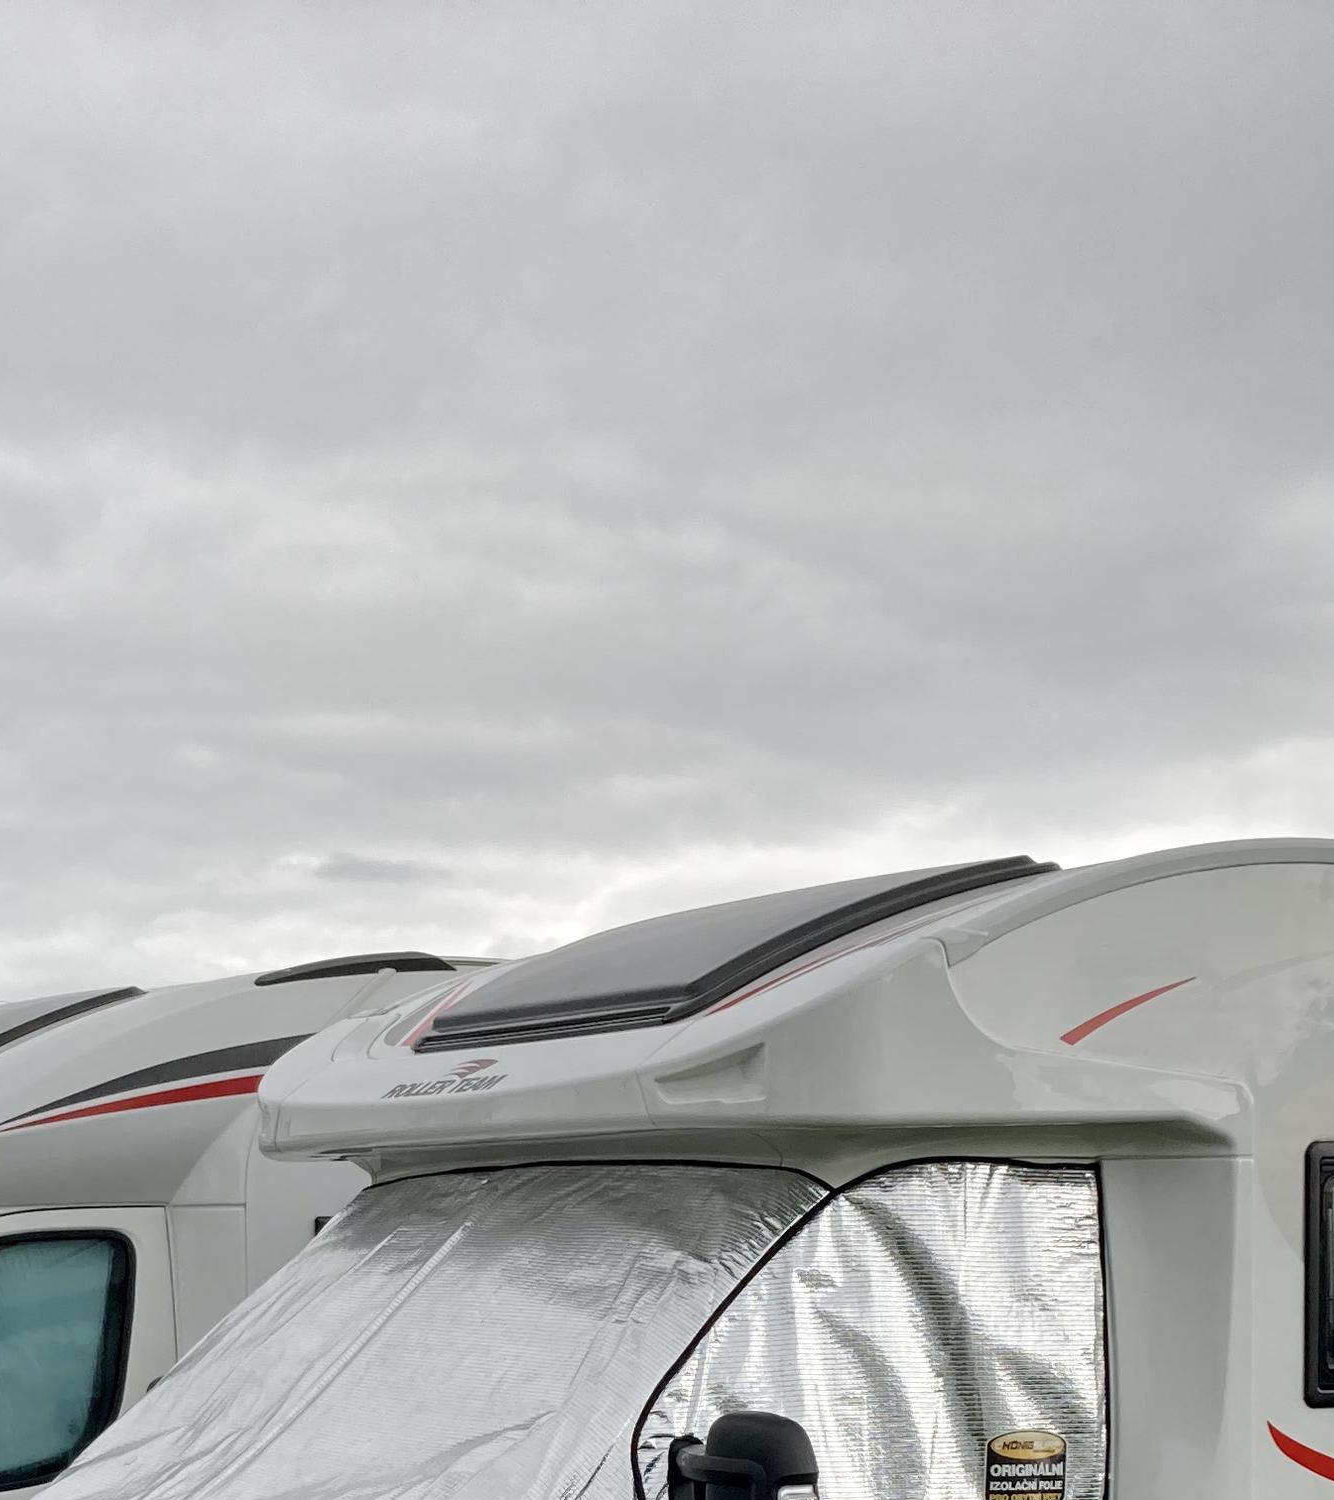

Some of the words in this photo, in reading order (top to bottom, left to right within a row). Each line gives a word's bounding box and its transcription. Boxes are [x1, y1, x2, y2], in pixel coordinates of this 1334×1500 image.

[381, 1080, 456, 1099] ROLLER
[447, 1074, 508, 1094] TEAM
[1038, 1480, 1063, 1490] FOLIE
